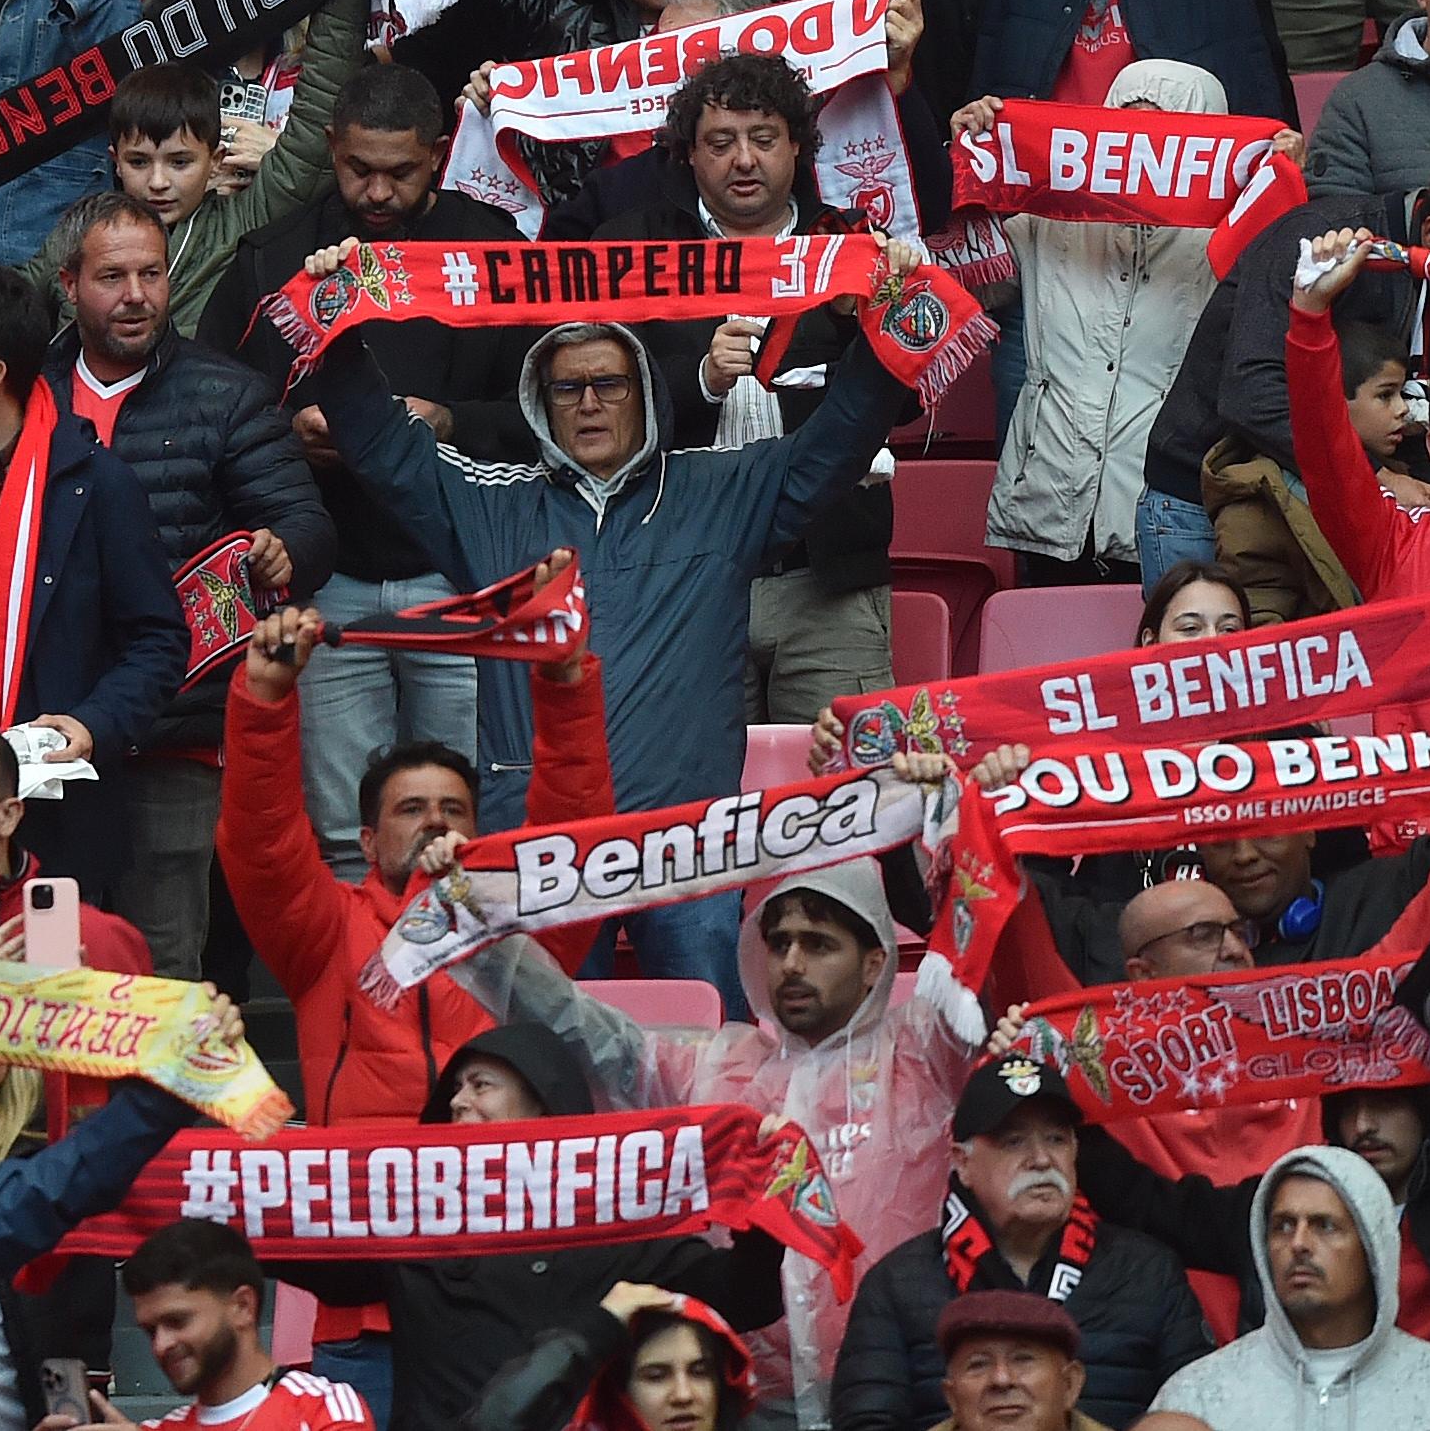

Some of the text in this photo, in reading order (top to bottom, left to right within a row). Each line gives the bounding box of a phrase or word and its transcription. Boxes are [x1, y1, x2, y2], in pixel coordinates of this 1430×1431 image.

[969, 121, 1032, 187] SL
[1040, 630, 1374, 736] SL BENFICA
[1142, 743, 1257, 800] DO
[1182, 786, 1387, 825] ISSO ME ENVAIDECE
[513, 777, 882, 918] Benfica
[1110, 969, 1395, 1105] SPORT LISBOA
[180, 1124, 711, 1239] #PELOBENFICA
